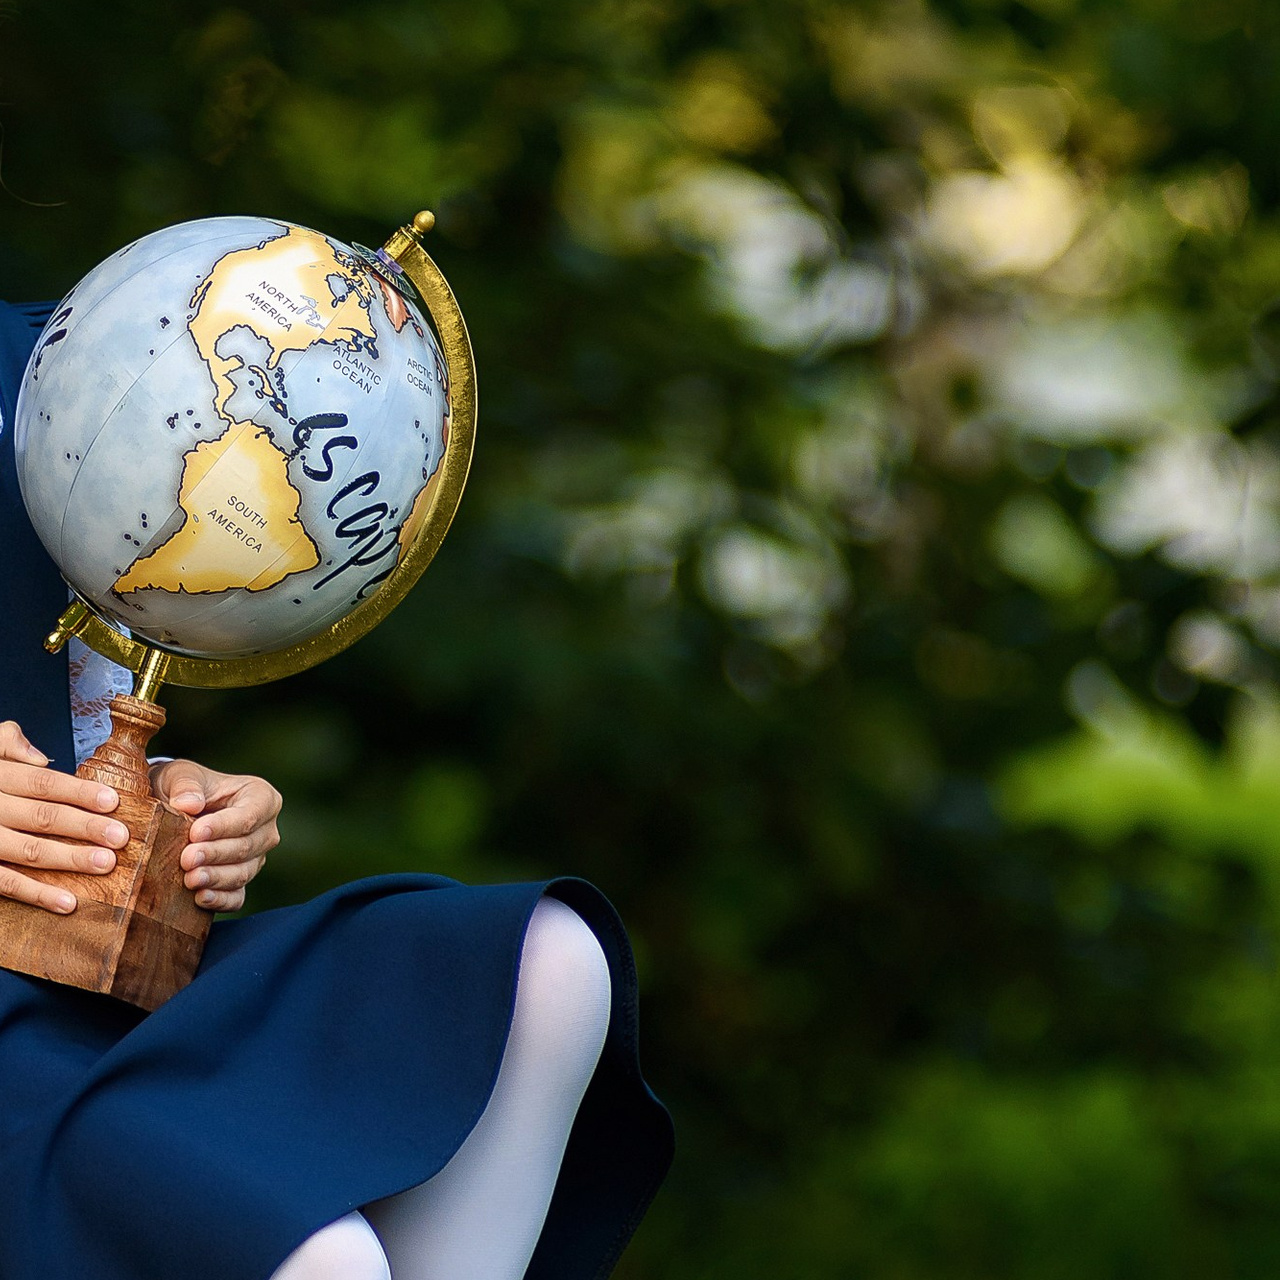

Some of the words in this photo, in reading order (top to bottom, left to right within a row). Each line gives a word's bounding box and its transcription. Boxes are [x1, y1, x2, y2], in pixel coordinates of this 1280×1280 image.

[245, 292, 293, 332] AMERICA
[258, 280, 299, 313] NORTH
[332, 345, 382, 386] ATLANTIC
[332, 359, 373, 394] OCEAN
[406, 358, 433, 382] ARCTIC
[406, 373, 433, 396] OCEAN
[227, 495, 268, 529] SOUTH
[207, 509, 263, 553] AMERICA
